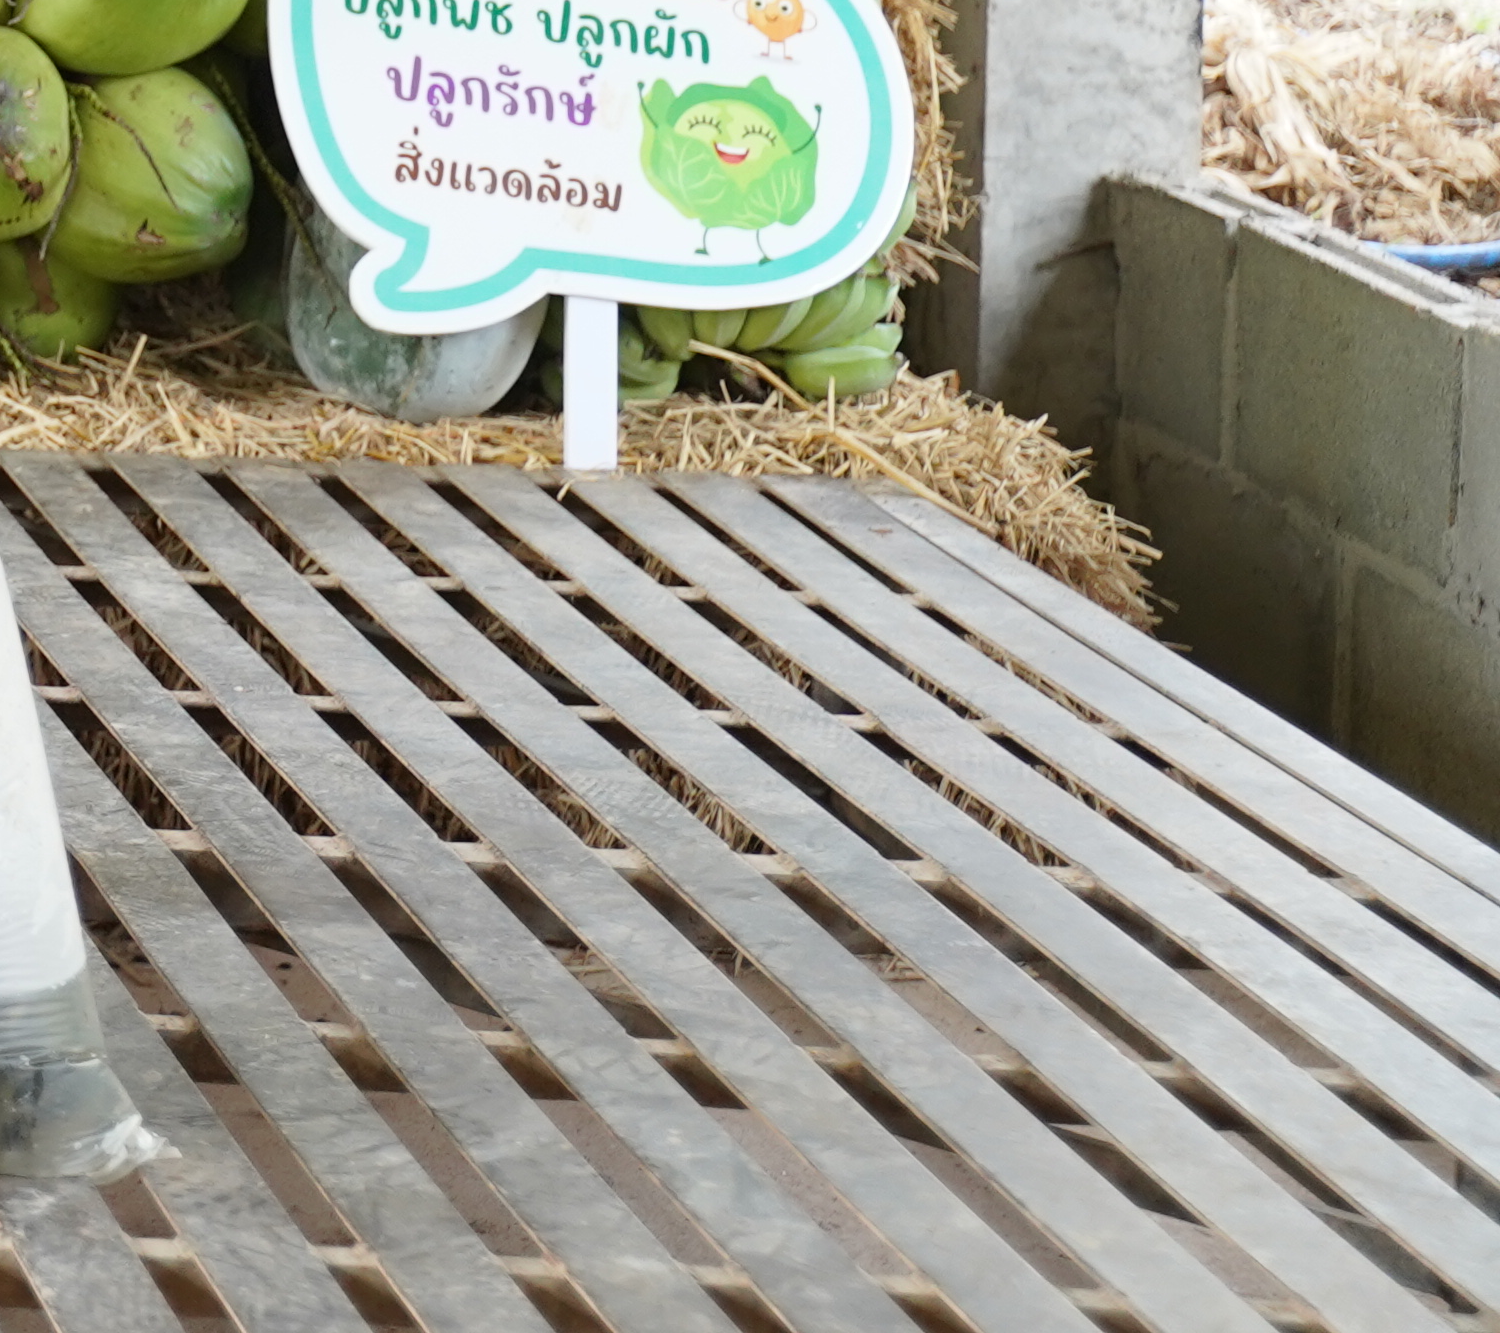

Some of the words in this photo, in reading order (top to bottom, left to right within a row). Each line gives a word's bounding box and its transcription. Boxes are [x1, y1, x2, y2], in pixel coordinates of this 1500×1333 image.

[386, 55, 598, 128] ปลูกรักษ์
[394, 127, 624, 213] สิ่งแวดล้อม
